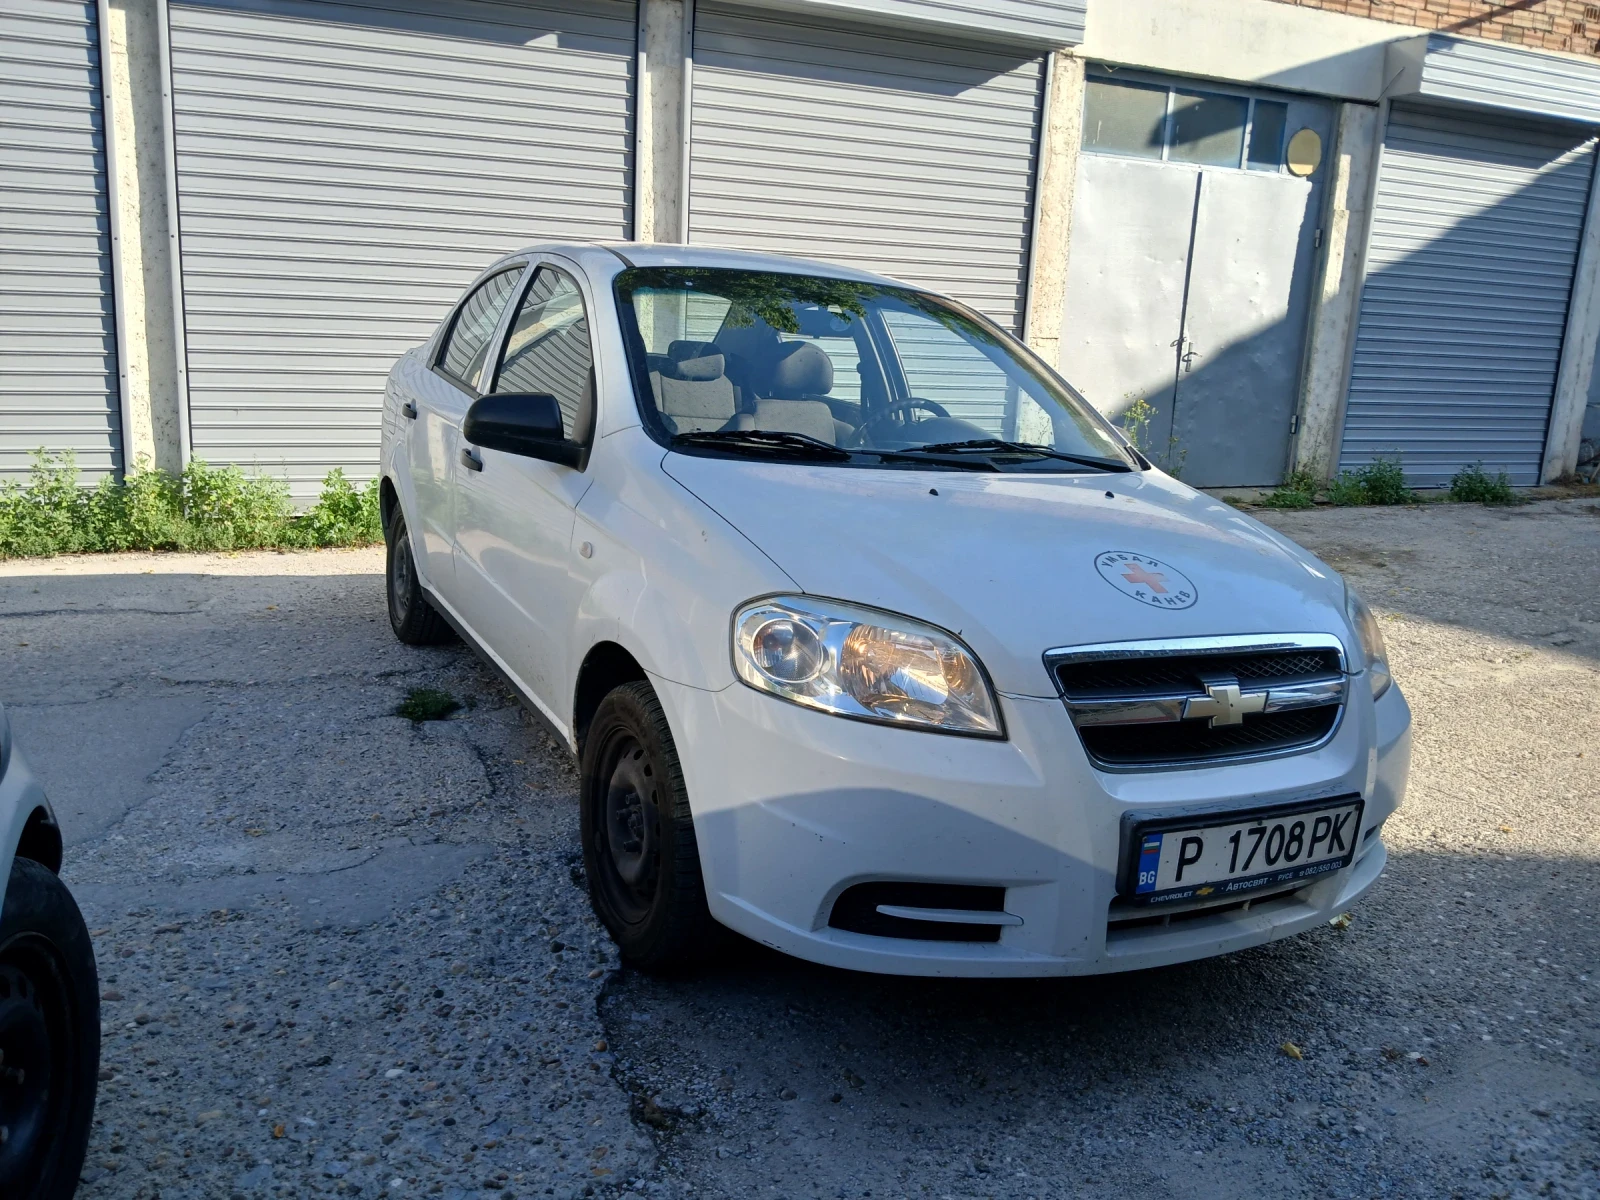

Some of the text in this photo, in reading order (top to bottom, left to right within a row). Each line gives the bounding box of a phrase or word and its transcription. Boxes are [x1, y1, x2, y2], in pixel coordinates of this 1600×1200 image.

[1101, 554, 1159, 568] УМБАЛ
[1135, 590, 1191, 605] КАНЕВ
[1175, 836, 1204, 882] P
[1138, 870, 1156, 886] BG
[1150, 890, 1193, 903] CHEVROLET
